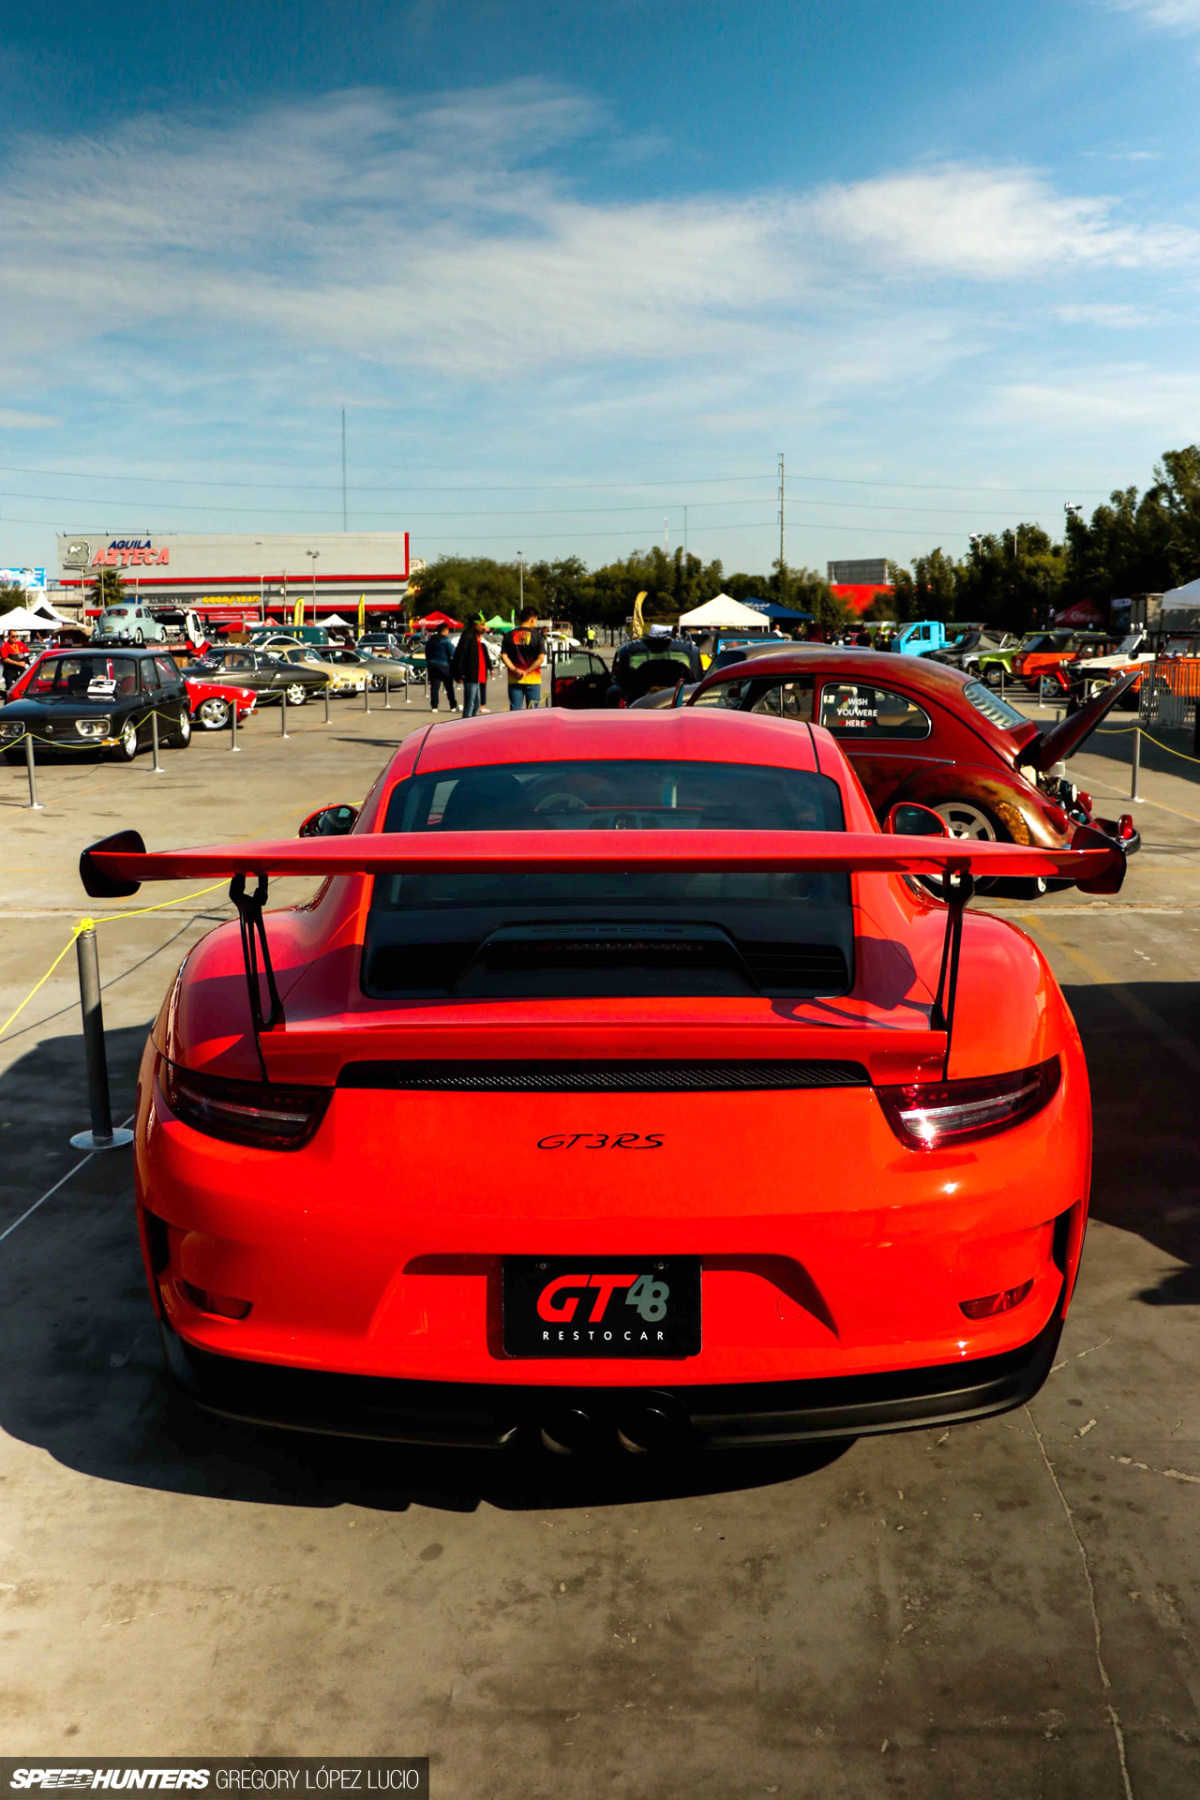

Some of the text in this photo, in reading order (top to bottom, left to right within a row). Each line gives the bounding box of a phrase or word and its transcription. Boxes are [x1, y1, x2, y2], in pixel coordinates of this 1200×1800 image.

[108, 540, 151, 549] AGUILA
[92, 548, 169, 566] AZTECA
[837, 708, 878, 717] YOU WERE
[537, 1133, 665, 1149] GT3RS
[537, 1274, 670, 1322] GT48
[542, 1331, 664, 1341] RESTOCAR
